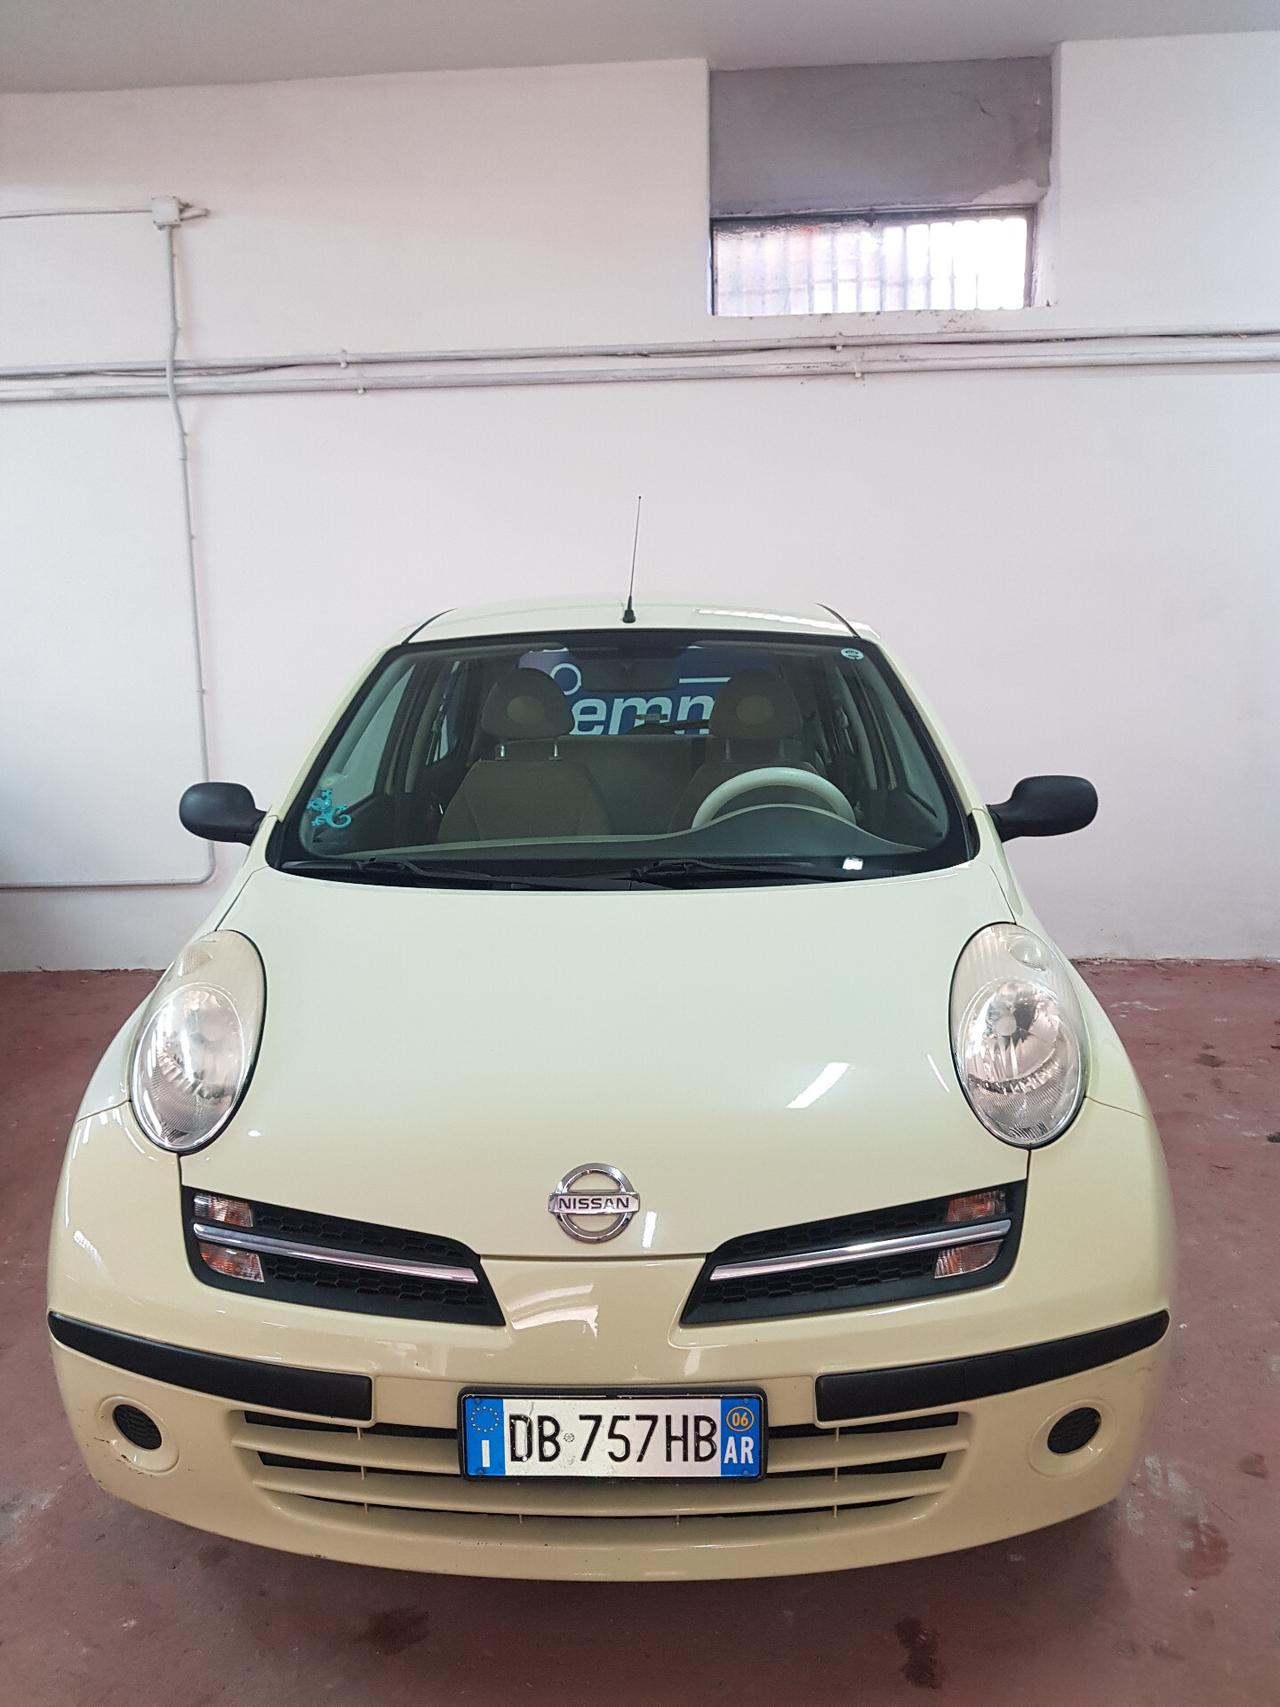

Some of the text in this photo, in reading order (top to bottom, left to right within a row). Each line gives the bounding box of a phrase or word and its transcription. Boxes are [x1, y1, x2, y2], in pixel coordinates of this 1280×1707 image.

[558, 1197, 629, 1210] NISSAN
[732, 1412, 749, 1427] 06
[508, 1413, 717, 1462] DB 757HB
[723, 1436, 754, 1464] AR
[481, 1439, 491, 1468] I
